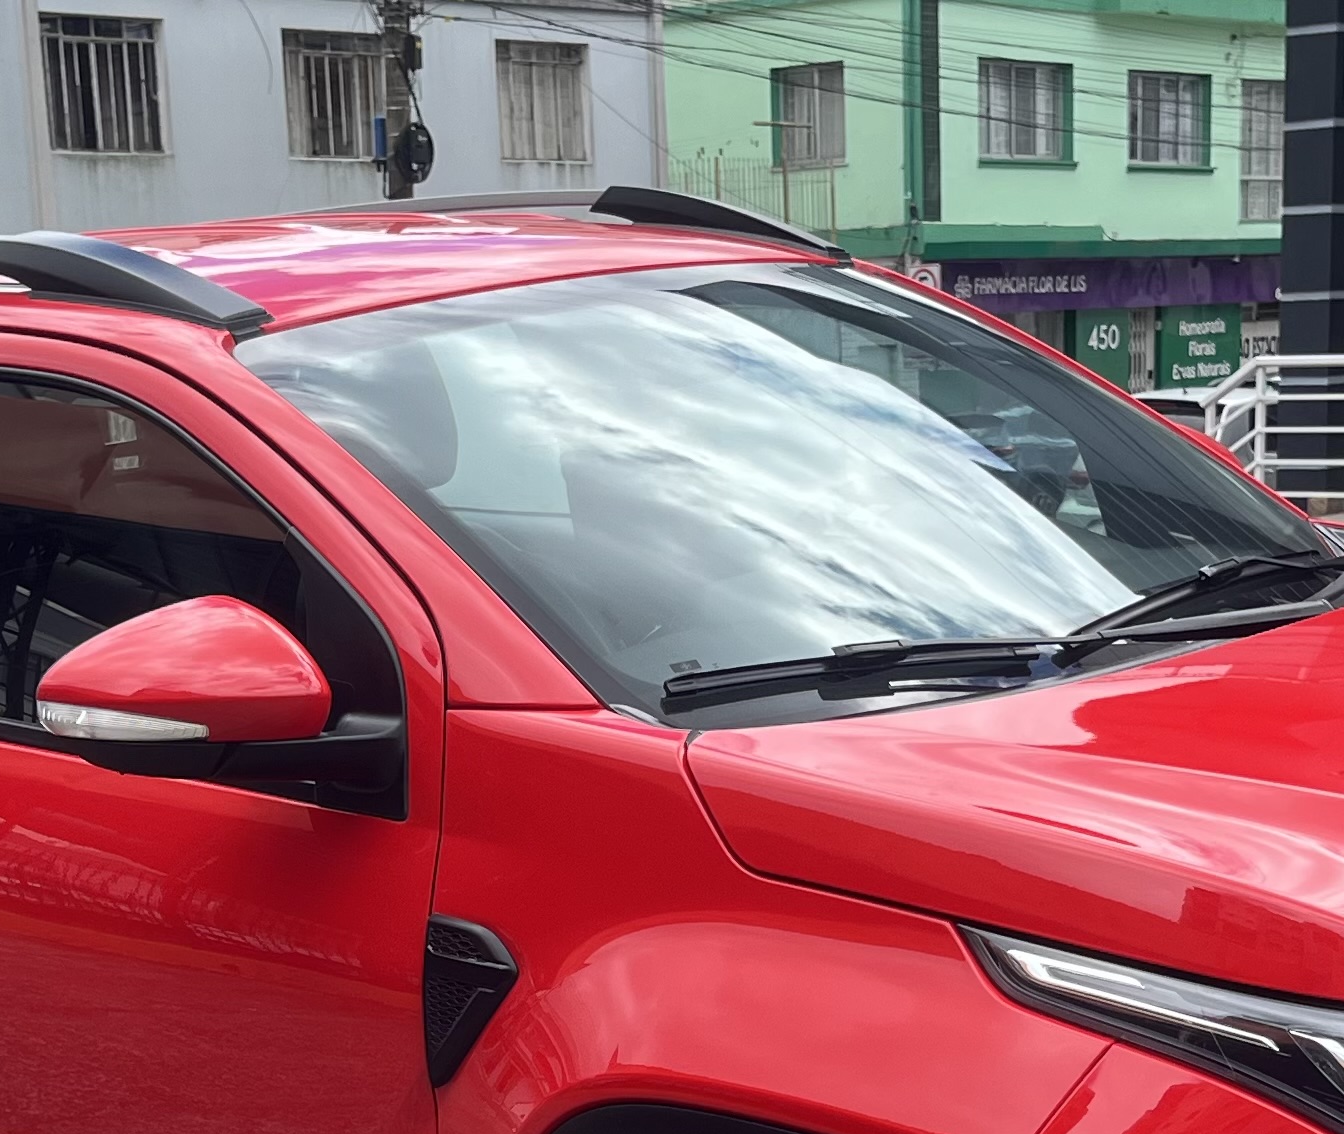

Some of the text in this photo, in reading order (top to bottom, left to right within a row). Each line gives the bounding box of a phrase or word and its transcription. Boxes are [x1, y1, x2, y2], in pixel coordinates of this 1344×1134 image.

[974, 273, 1088, 295] FARMÁCIA FLOR DE LIS
[1088, 324, 1121, 351] 450
